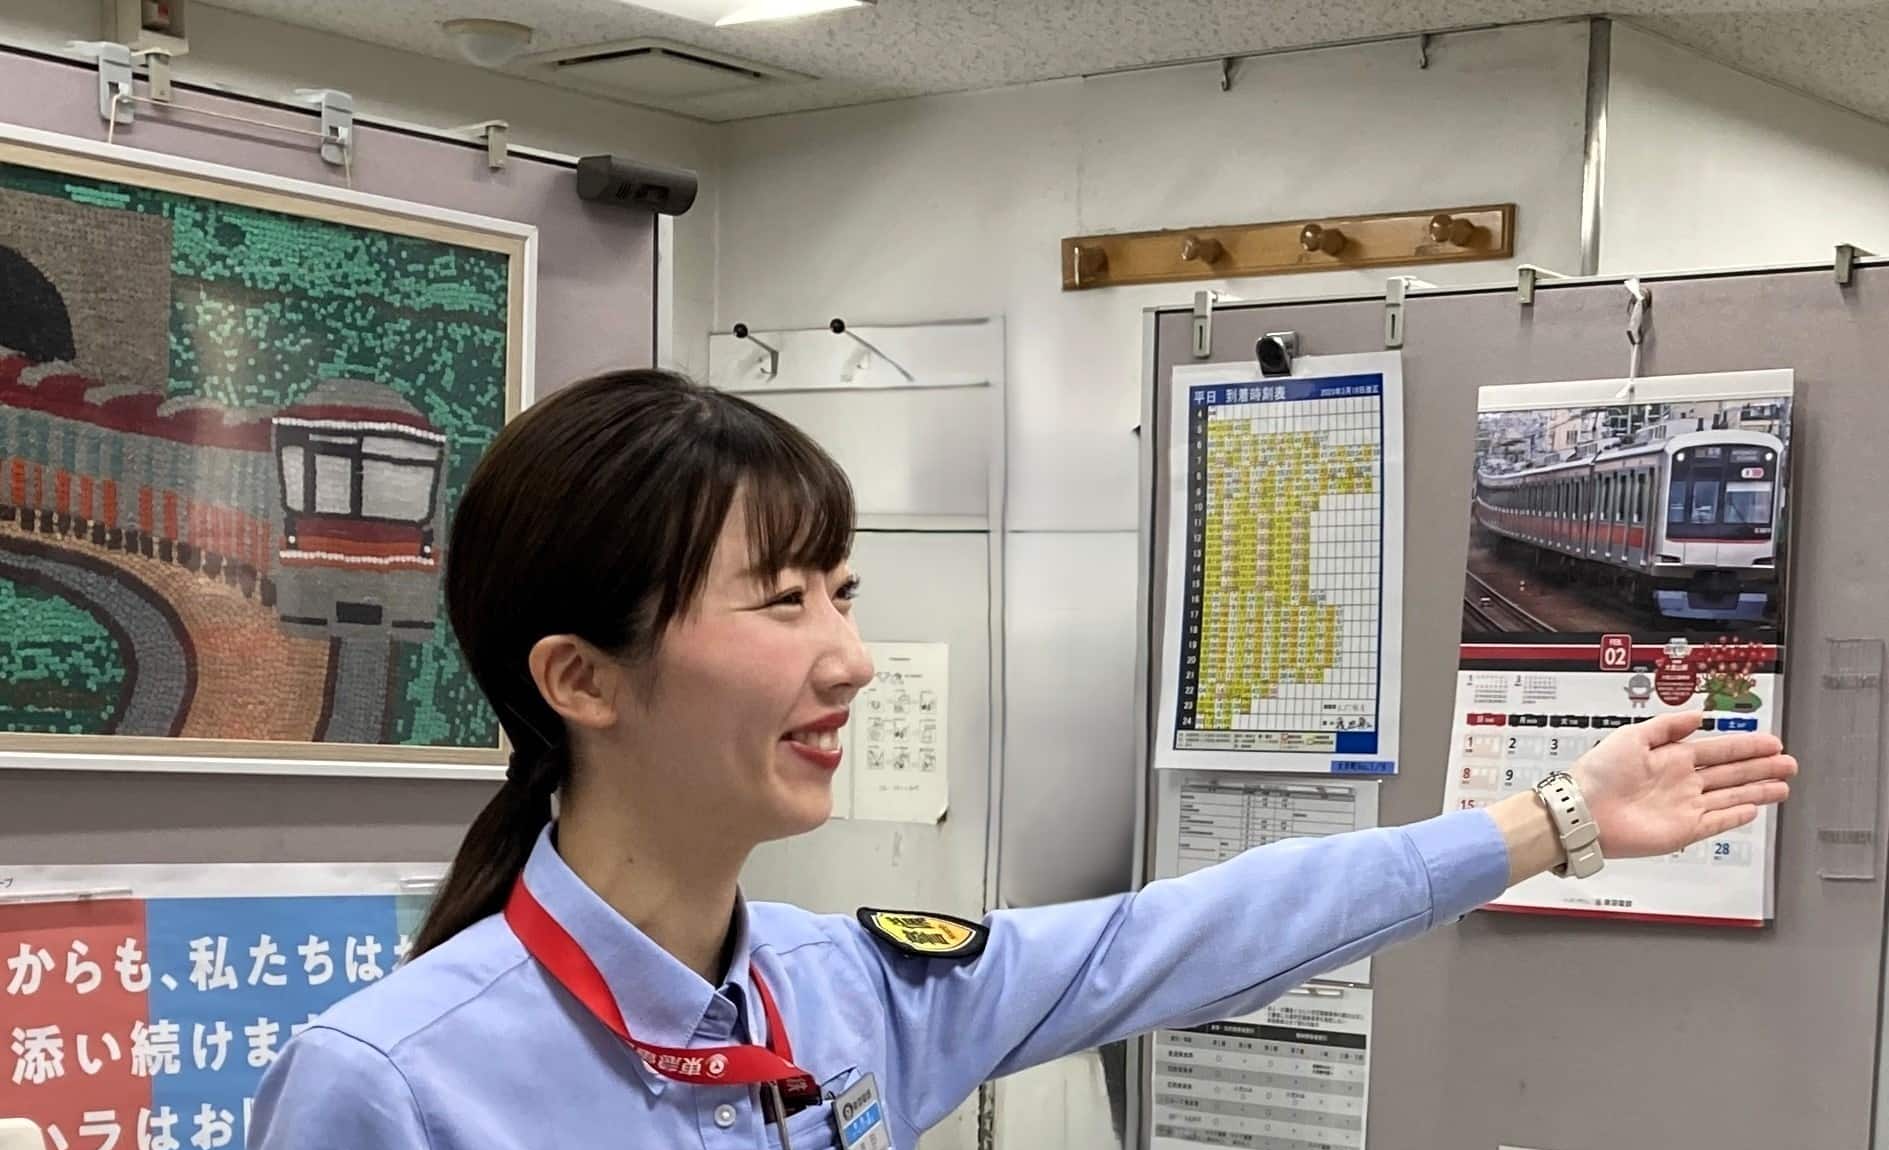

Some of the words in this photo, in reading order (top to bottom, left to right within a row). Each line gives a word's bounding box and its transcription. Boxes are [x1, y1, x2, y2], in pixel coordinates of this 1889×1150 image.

[1194, 390, 1217, 404] 平日
[1225, 386, 1286, 403] 到着時刻表
[1605, 647, 1626, 665] 02
[1467, 737, 1473, 747] 1
[1508, 737, 1517, 749] 2
[1550, 739, 1558, 750] 3
[1463, 768, 1471, 779] 8
[1505, 769, 1514, 781] 9
[1714, 843, 1730, 855] 28
